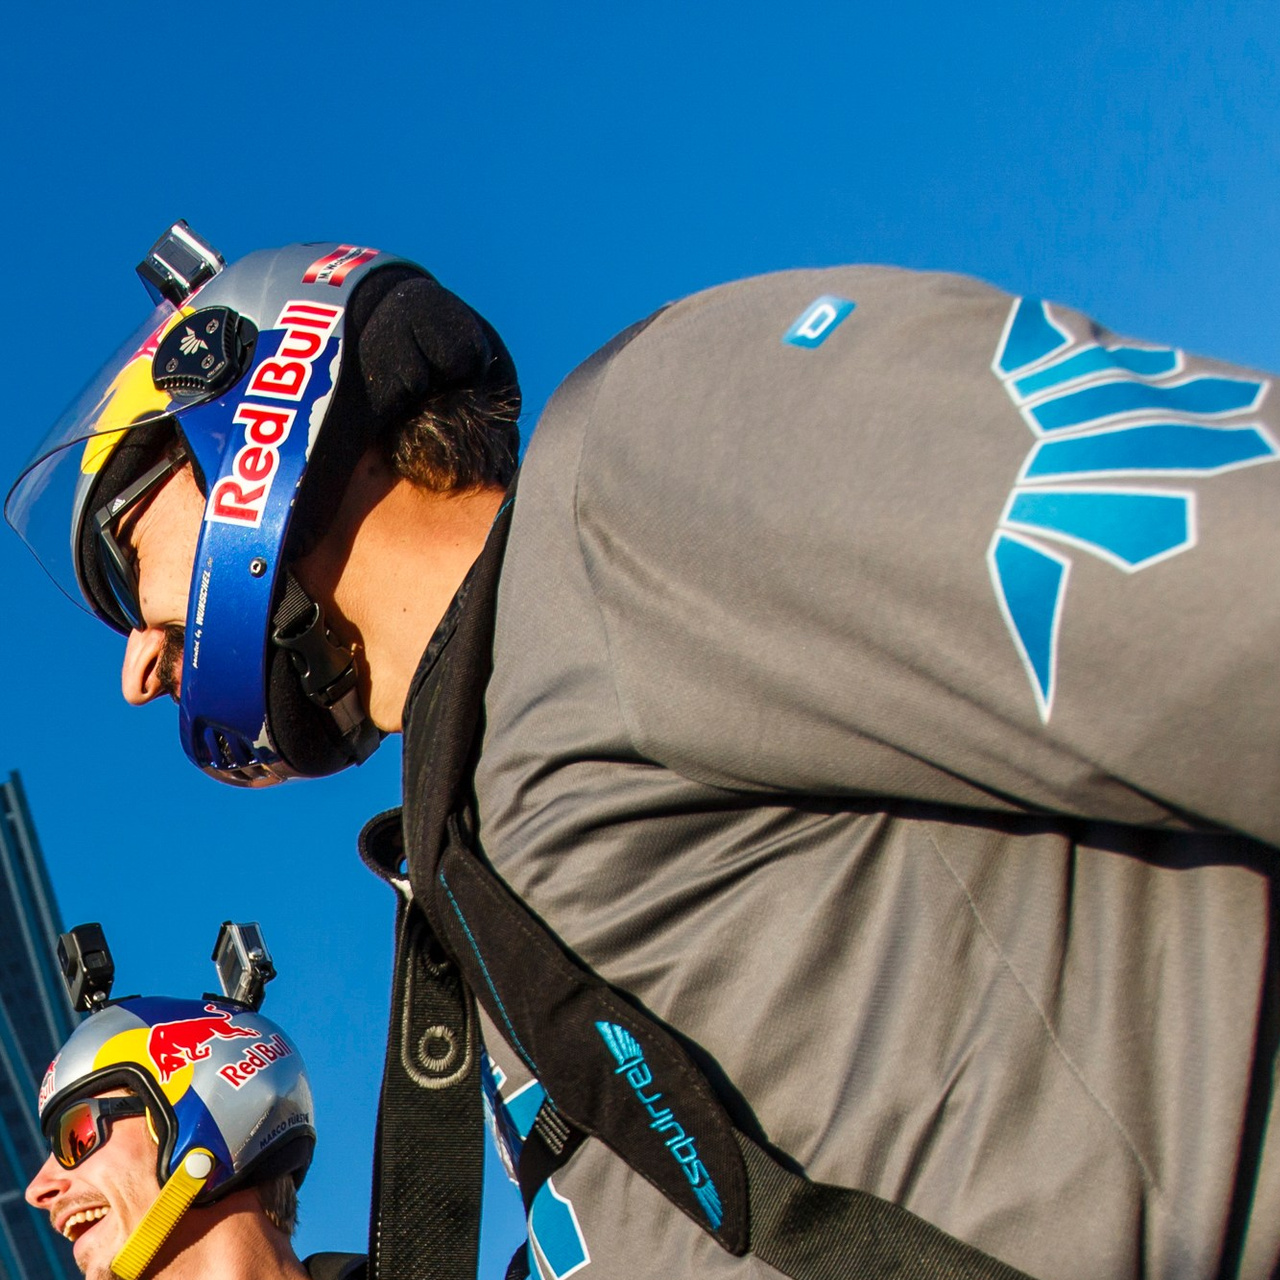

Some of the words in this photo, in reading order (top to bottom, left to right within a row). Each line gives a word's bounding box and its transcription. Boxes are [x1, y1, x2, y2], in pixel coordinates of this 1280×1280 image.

[249, 304, 342, 397] Bull
[211, 406, 295, 525] Red
[219, 1050, 266, 1088] Red
[261, 1035, 291, 1066] Bull
[260, 1121, 287, 1150] MARCO
[615, 1056, 711, 1188] squirrel
